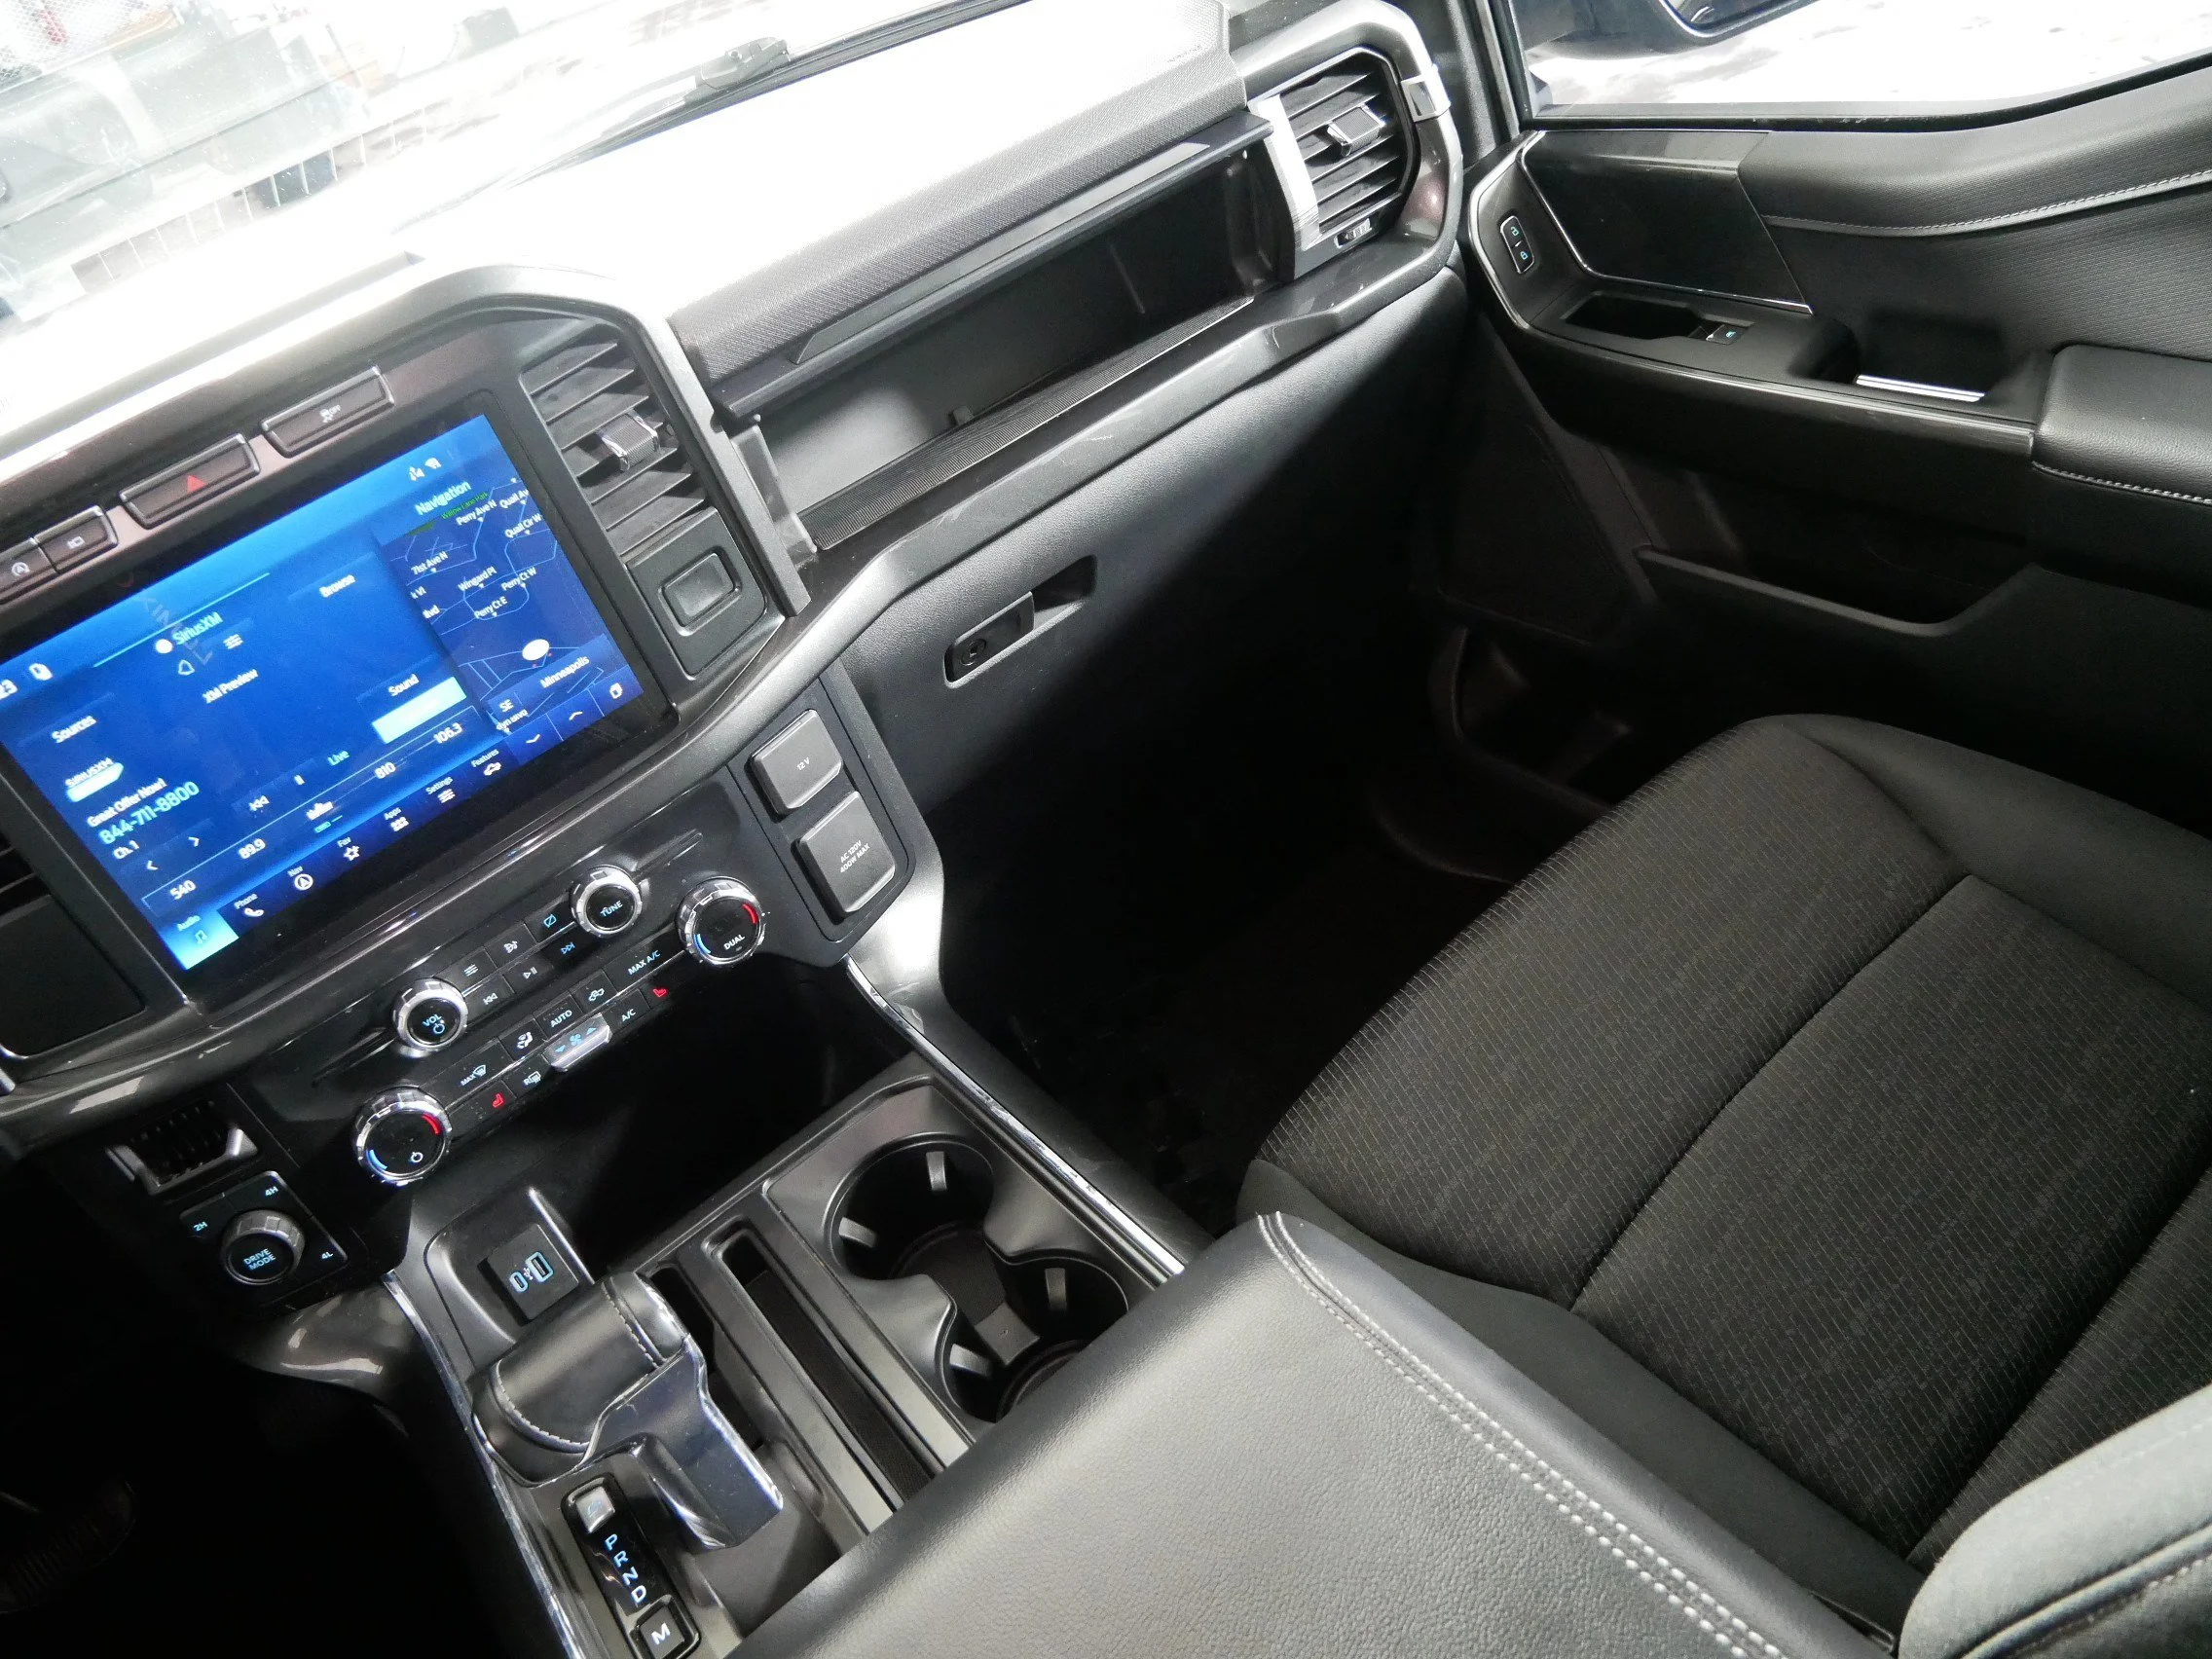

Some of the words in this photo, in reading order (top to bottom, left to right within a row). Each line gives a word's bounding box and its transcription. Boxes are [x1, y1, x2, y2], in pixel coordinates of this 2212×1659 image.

[415, 481, 471, 515] Navigation
[499, 494, 517, 508] Quail
[456, 511, 477, 526] Perry
[475, 503, 490, 516] Ave
[487, 499, 498, 509] N
[505, 524, 525, 538] Quail
[411, 564, 428, 575] 71st
[426, 556, 441, 569] Ave
[438, 551, 449, 560] N
[501, 577, 521, 591] Perry
[474, 606, 495, 619] Perry
[171, 611, 223, 645] SiriusXM
[540, 656, 590, 688] Minneapolis
[202, 686, 224, 704] XM
[218, 669, 259, 695] Preview
[387, 674, 420, 696] Sound
[499, 699, 514, 713] SE
[52, 715, 97, 743] Sources
[433, 722, 463, 744] 106.3
[327, 751, 350, 766] Live
[470, 749, 499, 767] Features
[374, 761, 396, 780] 810
[425, 776, 454, 794] Settings
[87, 807, 118, 828] Great
[114, 795, 141, 813] Offer
[99, 781, 200, 844] 844-711-8800
[384, 806, 402, 820] Apps
[238, 838, 266, 859] 89.9
[337, 836, 351, 847] Fav
[840, 853, 850, 864] AC
[847, 839, 862, 855] 120V
[840, 855, 857, 873] 400W
[856, 842, 870, 858] MAX
[287, 866, 304, 877] Nav
[170, 879, 197, 901] 540
[234, 893, 258, 909] Phone
[600, 900, 624, 918] TUNE
[723, 934, 746, 950] DUAL
[627, 959, 646, 976] MAX
[646, 949, 661, 964] A/C
[422, 1014, 442, 1027] VOL
[550, 1010, 573, 1028] AUTO
[621, 1008, 637, 1022] A/C
[461, 1073, 476, 1086] MAX
[265, 1185, 279, 1198] 4H
[194, 1220, 208, 1232] 2H
[243, 1248, 273, 1265] DRIVE
[248, 1254, 276, 1271] MODE
[321, 1250, 333, 1261] 4L
[605, 1533, 618, 1551] P
[613, 1550, 629, 1568] R
[622, 1567, 639, 1586] N
[631, 1585, 647, 1604] D
[650, 1622, 671, 1645] M
